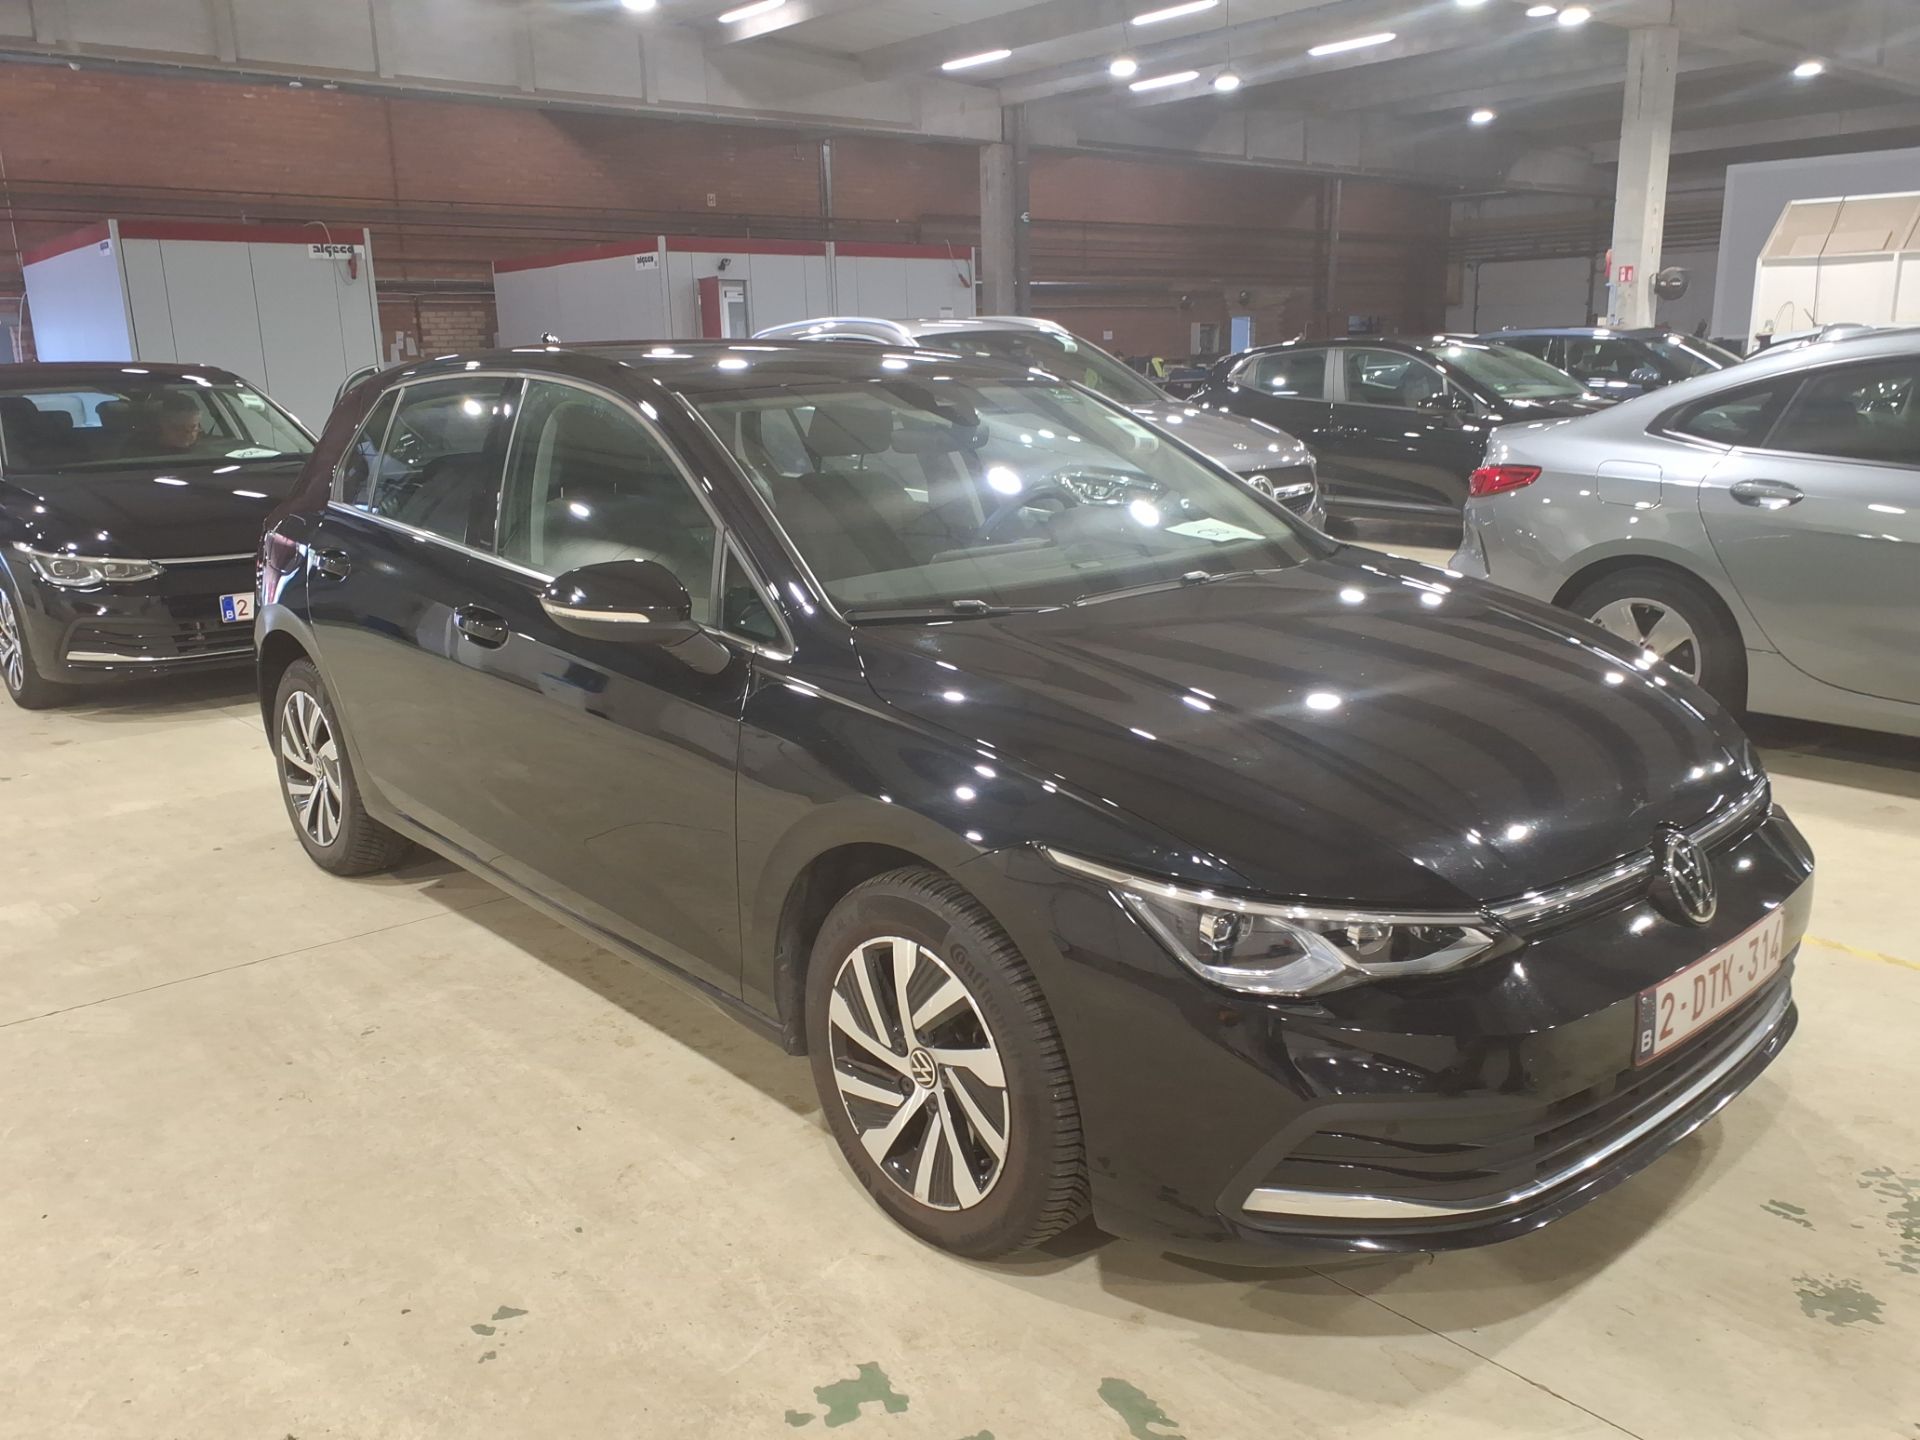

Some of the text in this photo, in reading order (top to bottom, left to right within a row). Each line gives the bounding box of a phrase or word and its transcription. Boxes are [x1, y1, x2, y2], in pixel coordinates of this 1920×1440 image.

[312, 244, 354, 257] algeco
[1659, 919, 1782, 1041] 2-DTK-314
[1641, 1029, 1653, 1053] B
